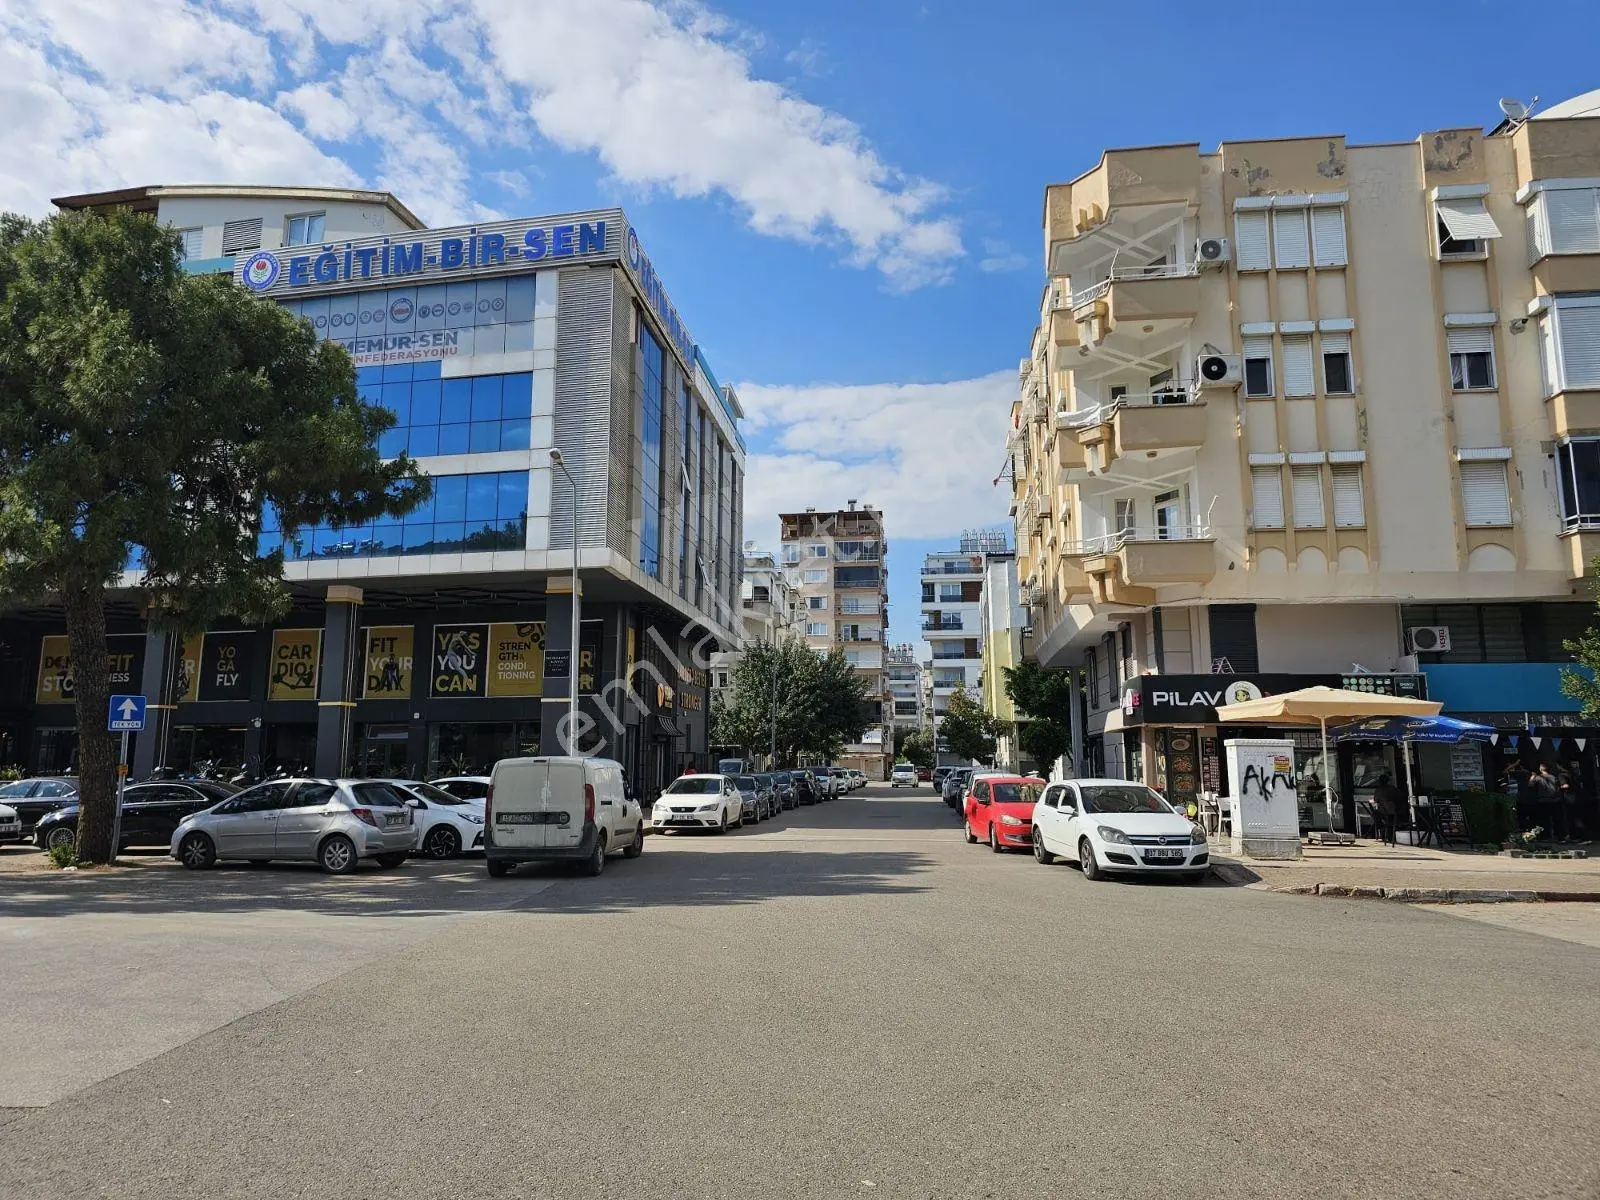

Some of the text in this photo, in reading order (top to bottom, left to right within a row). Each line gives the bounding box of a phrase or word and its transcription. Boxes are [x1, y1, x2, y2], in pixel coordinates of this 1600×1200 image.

[355, 347, 458, 365] NFEDERASYONU
[370, 636, 398, 653] FIT
[498, 641, 531, 651] STREN
[218, 646, 237, 659] YO
[277, 644, 312, 660] CAR
[217, 660, 236, 672] GA
[497, 661, 527, 671] CONDI
[216, 673, 239, 687] FLY
[496, 671, 536, 680] TIONING
[435, 673, 477, 692] CAN
